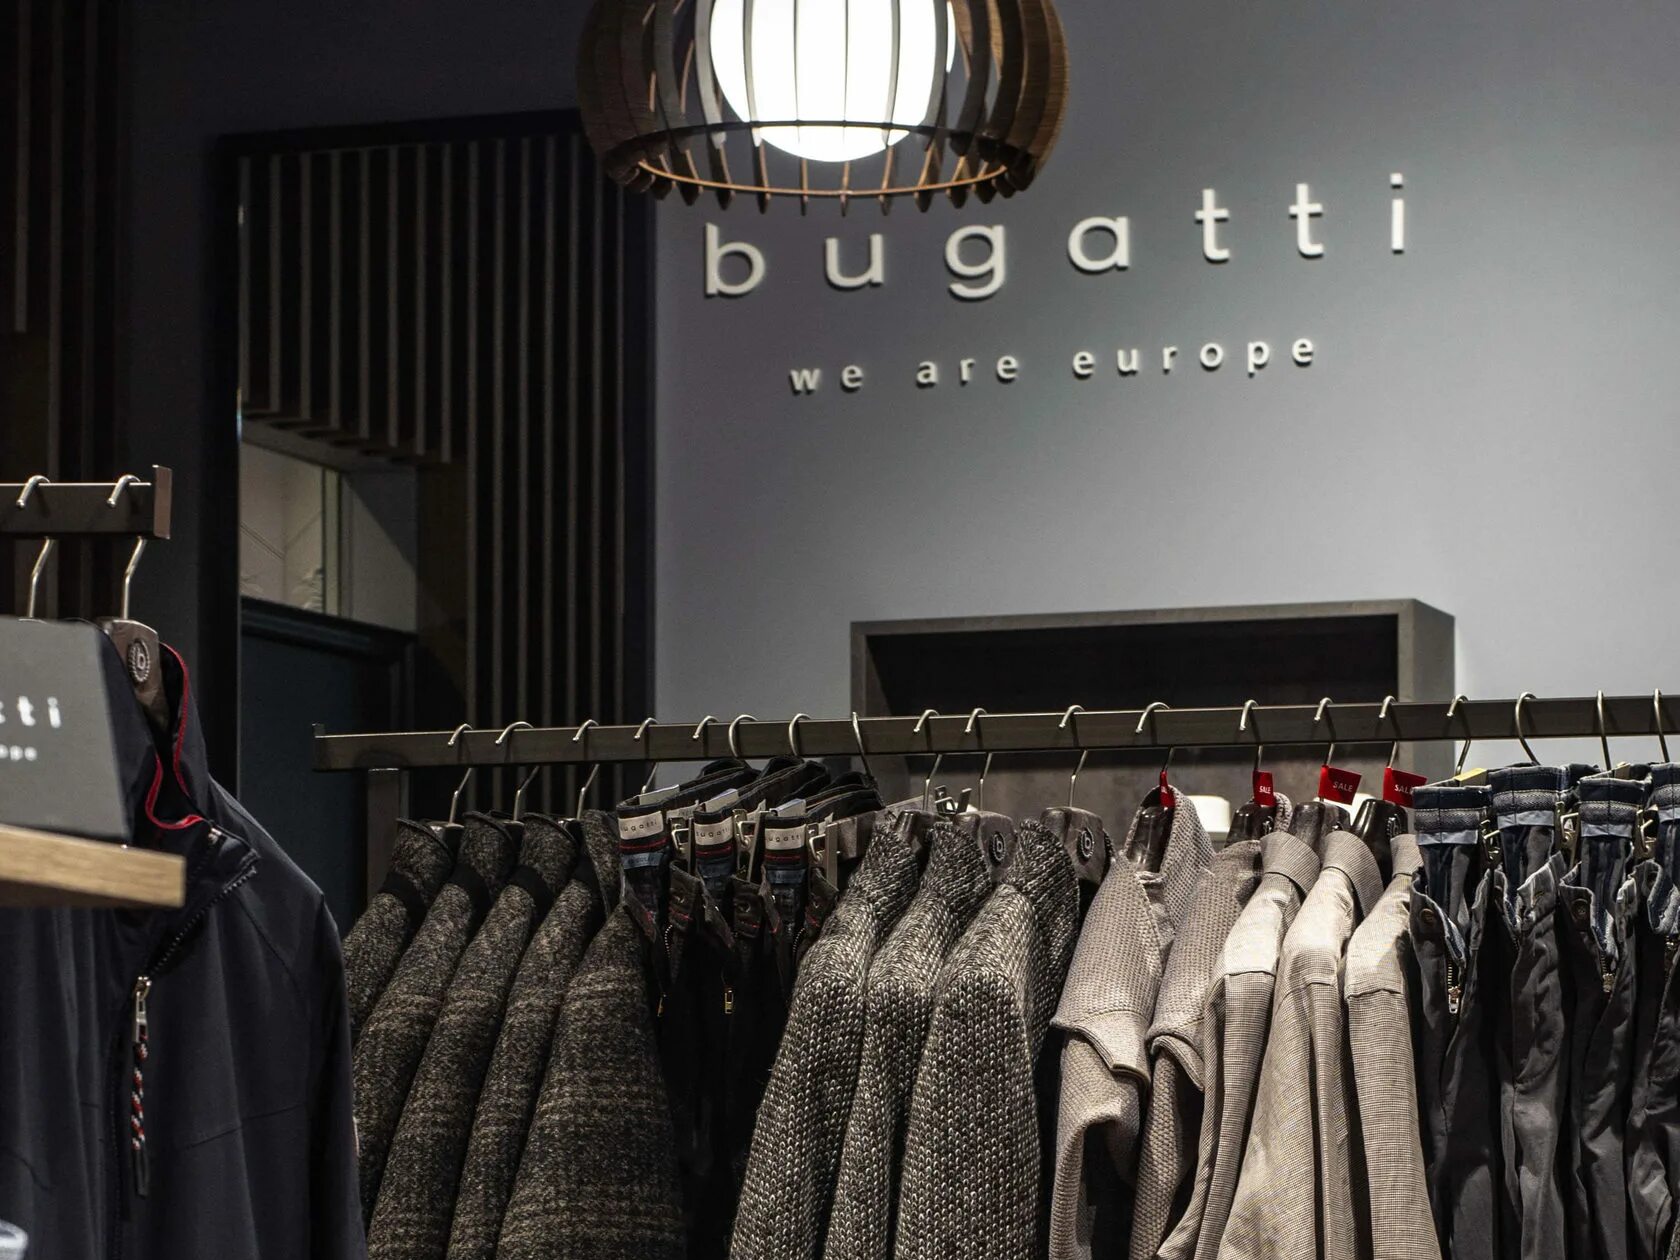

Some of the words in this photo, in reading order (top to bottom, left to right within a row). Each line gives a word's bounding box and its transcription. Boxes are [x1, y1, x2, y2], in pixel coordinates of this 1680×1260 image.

[704, 172, 1405, 299] bugatti
[790, 365, 864, 392] we
[915, 355, 1020, 387] are
[1071, 336, 1315, 377] europe
[1259, 785, 1271, 794] SALE
[1333, 781, 1354, 792] SALE
[621, 819, 657, 832] ugatti
